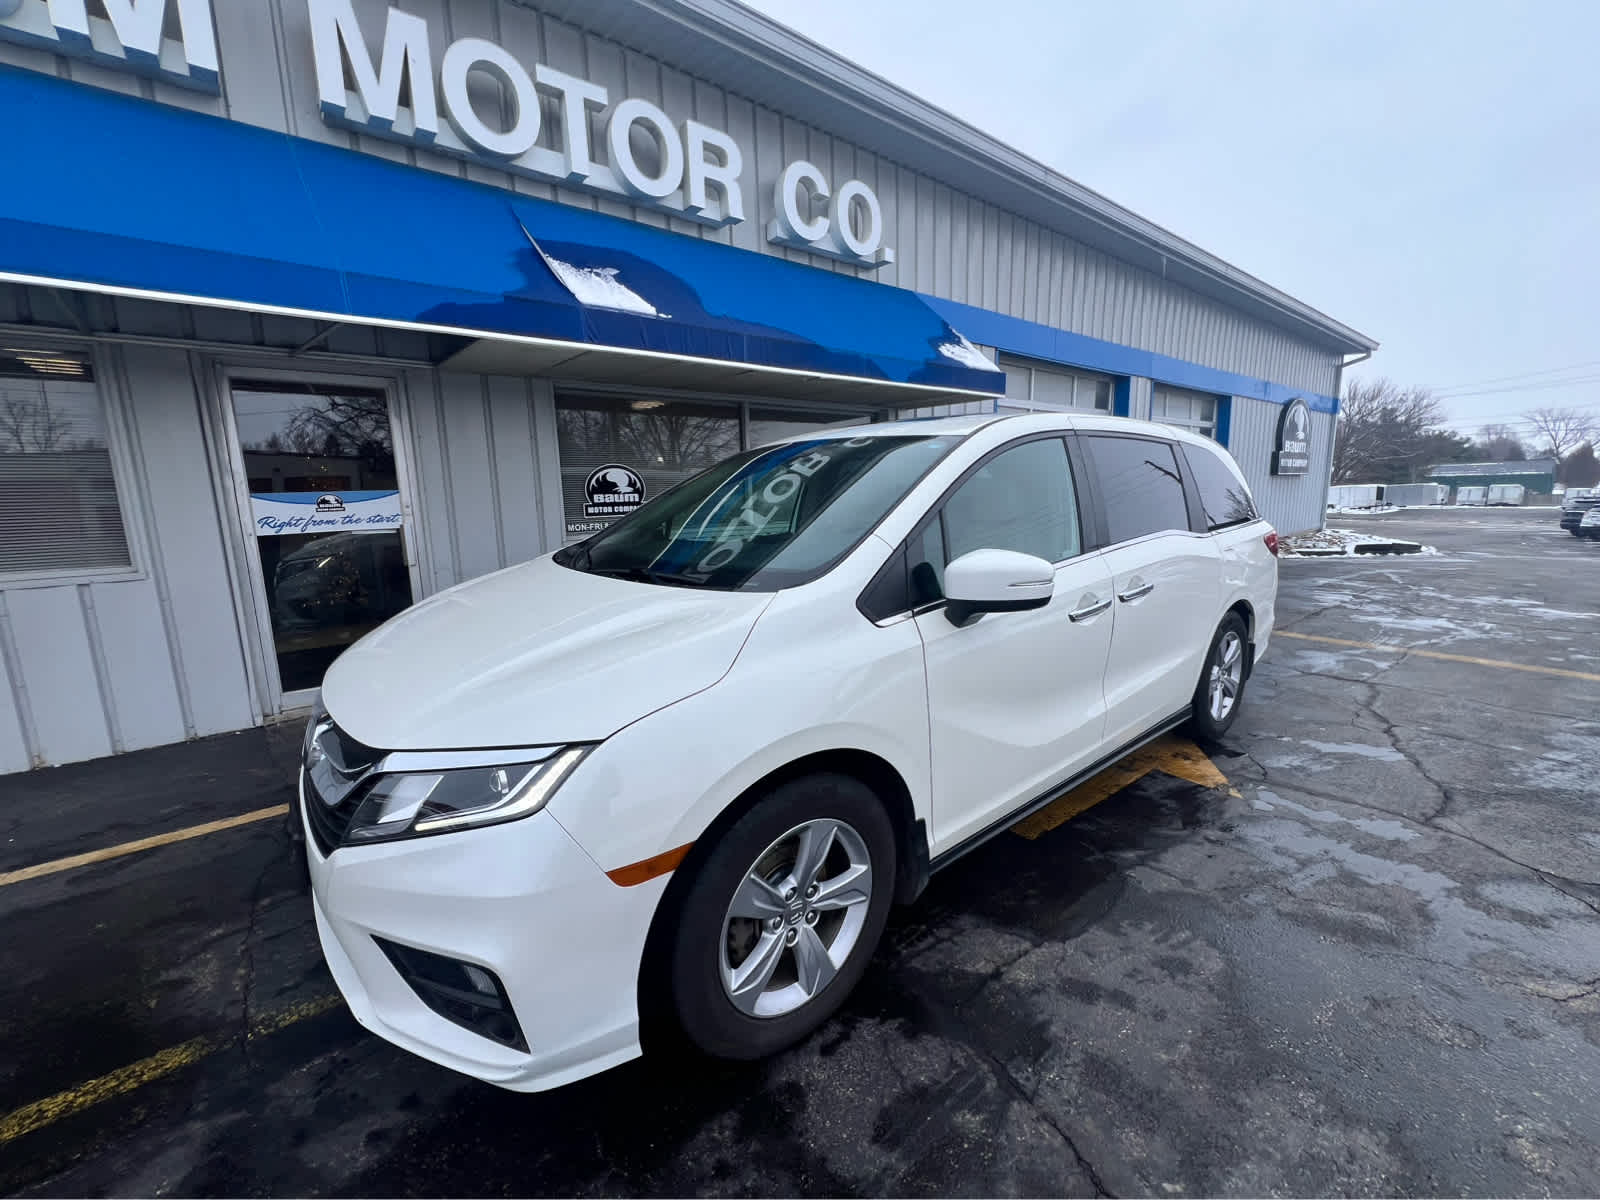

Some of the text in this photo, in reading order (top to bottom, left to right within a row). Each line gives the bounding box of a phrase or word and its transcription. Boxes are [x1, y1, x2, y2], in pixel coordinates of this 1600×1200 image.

[308, 0, 743, 222] MOTOR
[774, 160, 896, 266] CO.
[257, 516, 304, 534] Right
[301, 514, 338, 532] from
[340, 513, 362, 524] the
